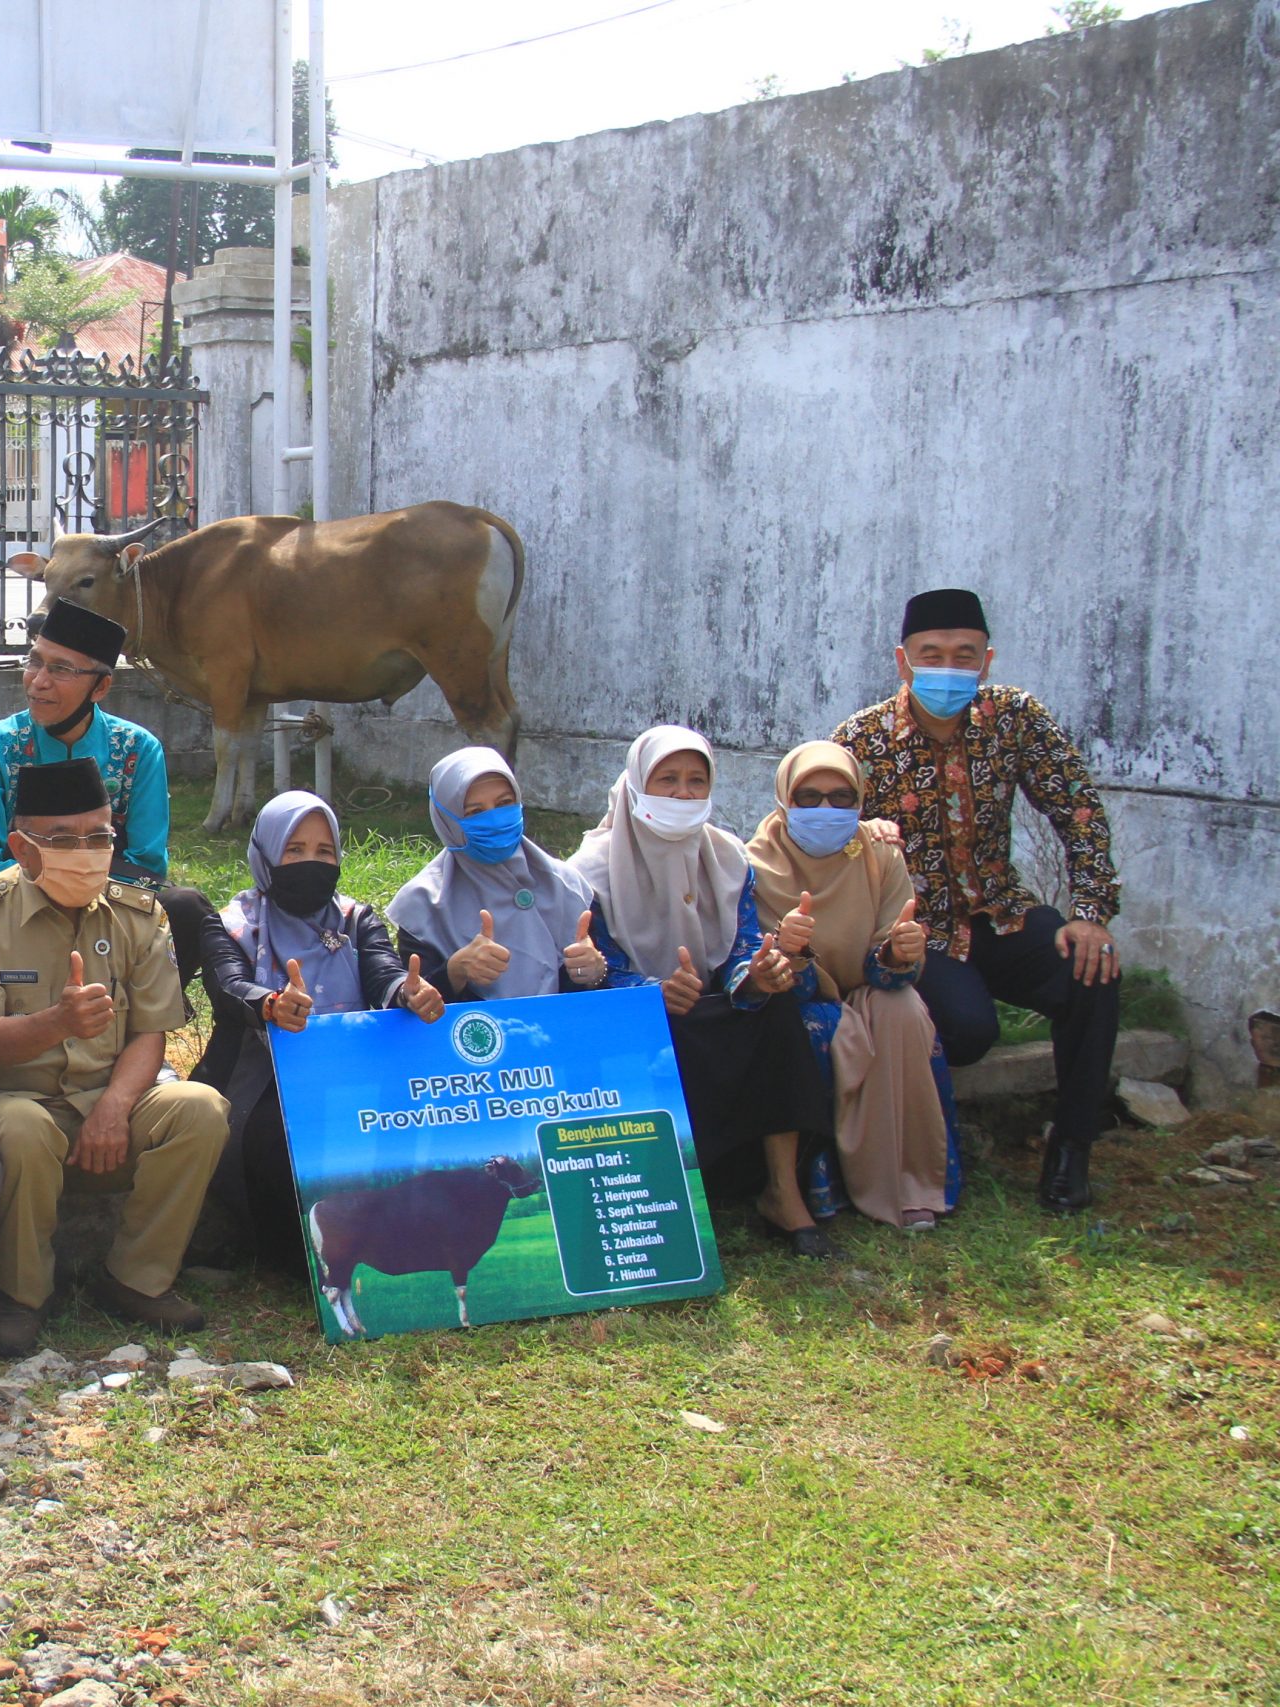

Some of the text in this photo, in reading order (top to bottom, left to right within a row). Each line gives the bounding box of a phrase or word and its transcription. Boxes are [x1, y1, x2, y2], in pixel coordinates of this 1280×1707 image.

[410, 1066, 552, 1098] PPRK MUI
[359, 1088, 620, 1132] Provinsi Bengkulu
[558, 1121, 655, 1142] Bengkulu Utara
[547, 1156, 593, 1174] Qurban
[596, 1151, 622, 1168] Dari
[590, 1174, 641, 1187] 1. Yuslidar
[592, 1189, 649, 1203] 2. Heriyono
[595, 1200, 677, 1219] 3. Septi Yuslinah
[599, 1220, 657, 1235] 4. Syafnizar
[602, 1234, 664, 1250] 5. Zulbaidah
[605, 1252, 647, 1266] 6. Evriza
[608, 1268, 656, 1282] 7. Hindun
